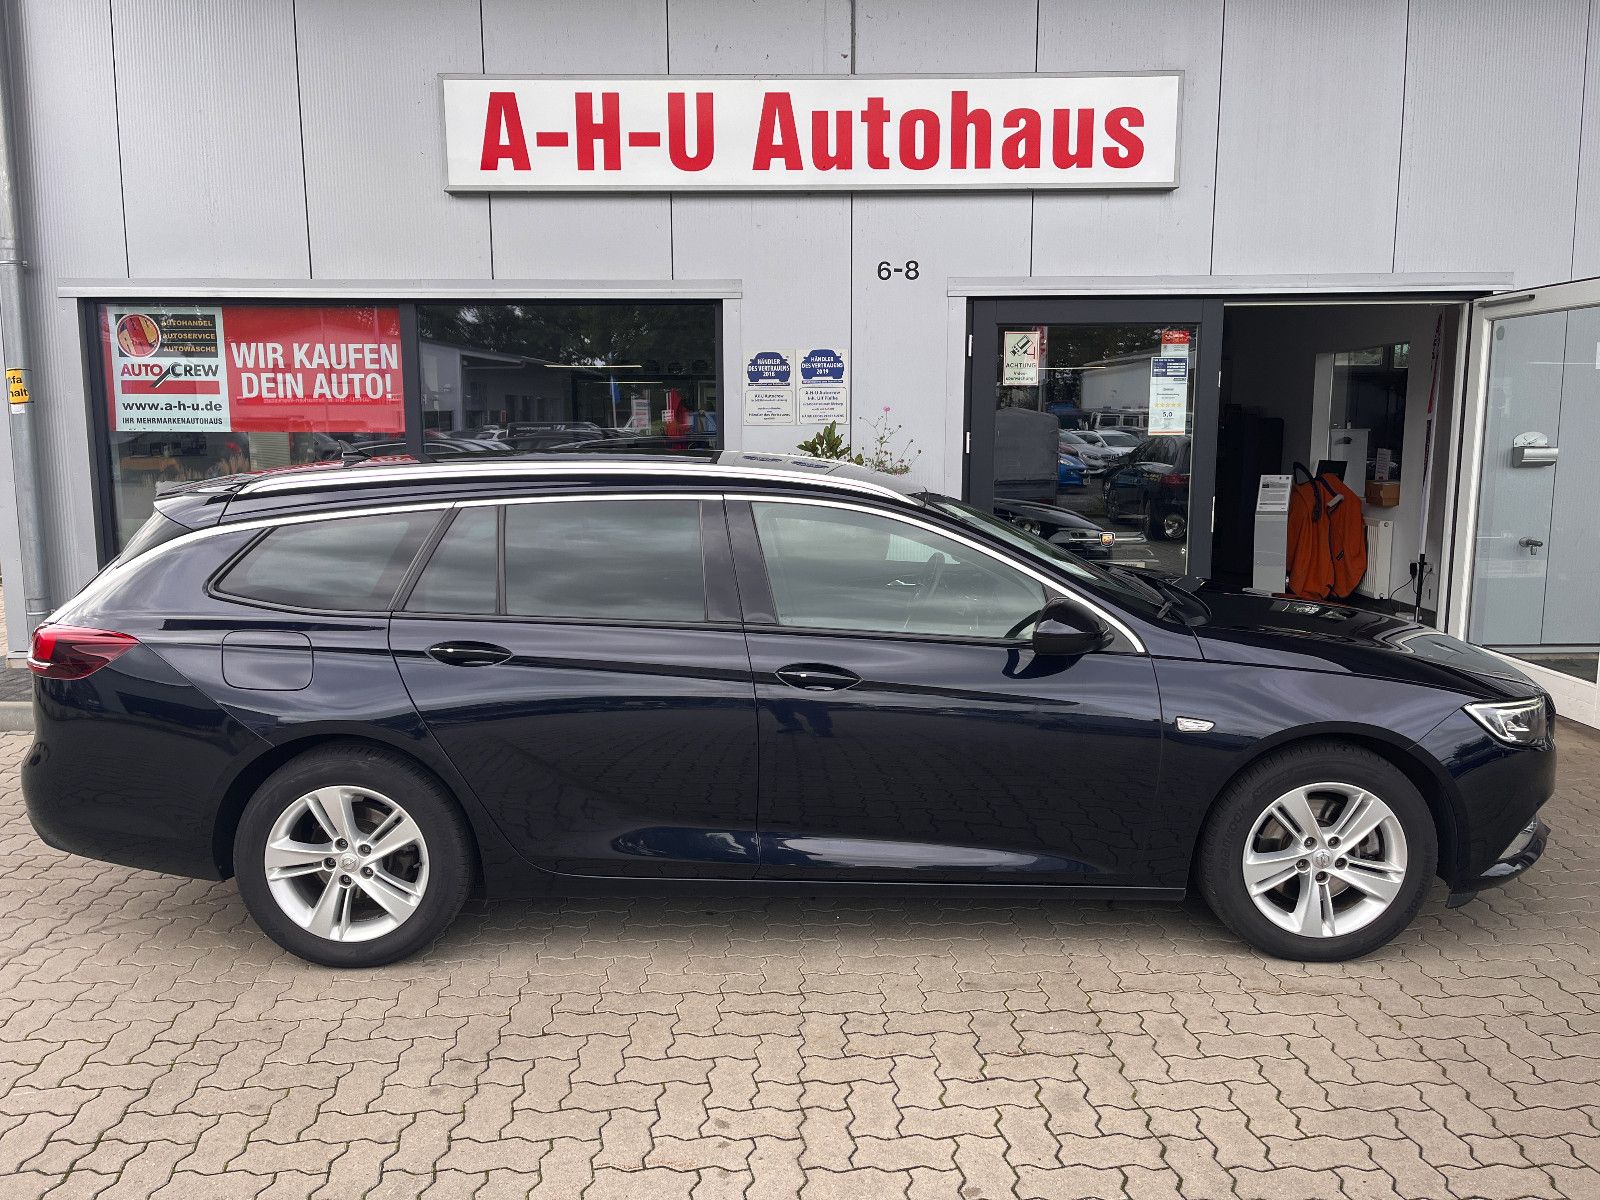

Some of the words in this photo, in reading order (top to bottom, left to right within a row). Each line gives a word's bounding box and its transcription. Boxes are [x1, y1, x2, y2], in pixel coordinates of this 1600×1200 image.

[480, 92, 714, 172] A-H-U
[752, 91, 1144, 171] Autohaus
[877, 260, 920, 281] 6-8
[161, 319, 213, 328] AUTOHANDEL
[162, 332, 215, 340] AUTOSERVICE
[231, 343, 284, 369] WIR
[293, 343, 398, 369] KAUFEN
[120, 363, 164, 377] AUTO
[170, 362, 219, 378] CREW
[240, 373, 303, 399] DEIN
[313, 373, 394, 399] AUTO!
[122, 401, 222, 411] www.a-h-u.de
[136, 417, 223, 425] MEHRMARKENAUTOHAUS
